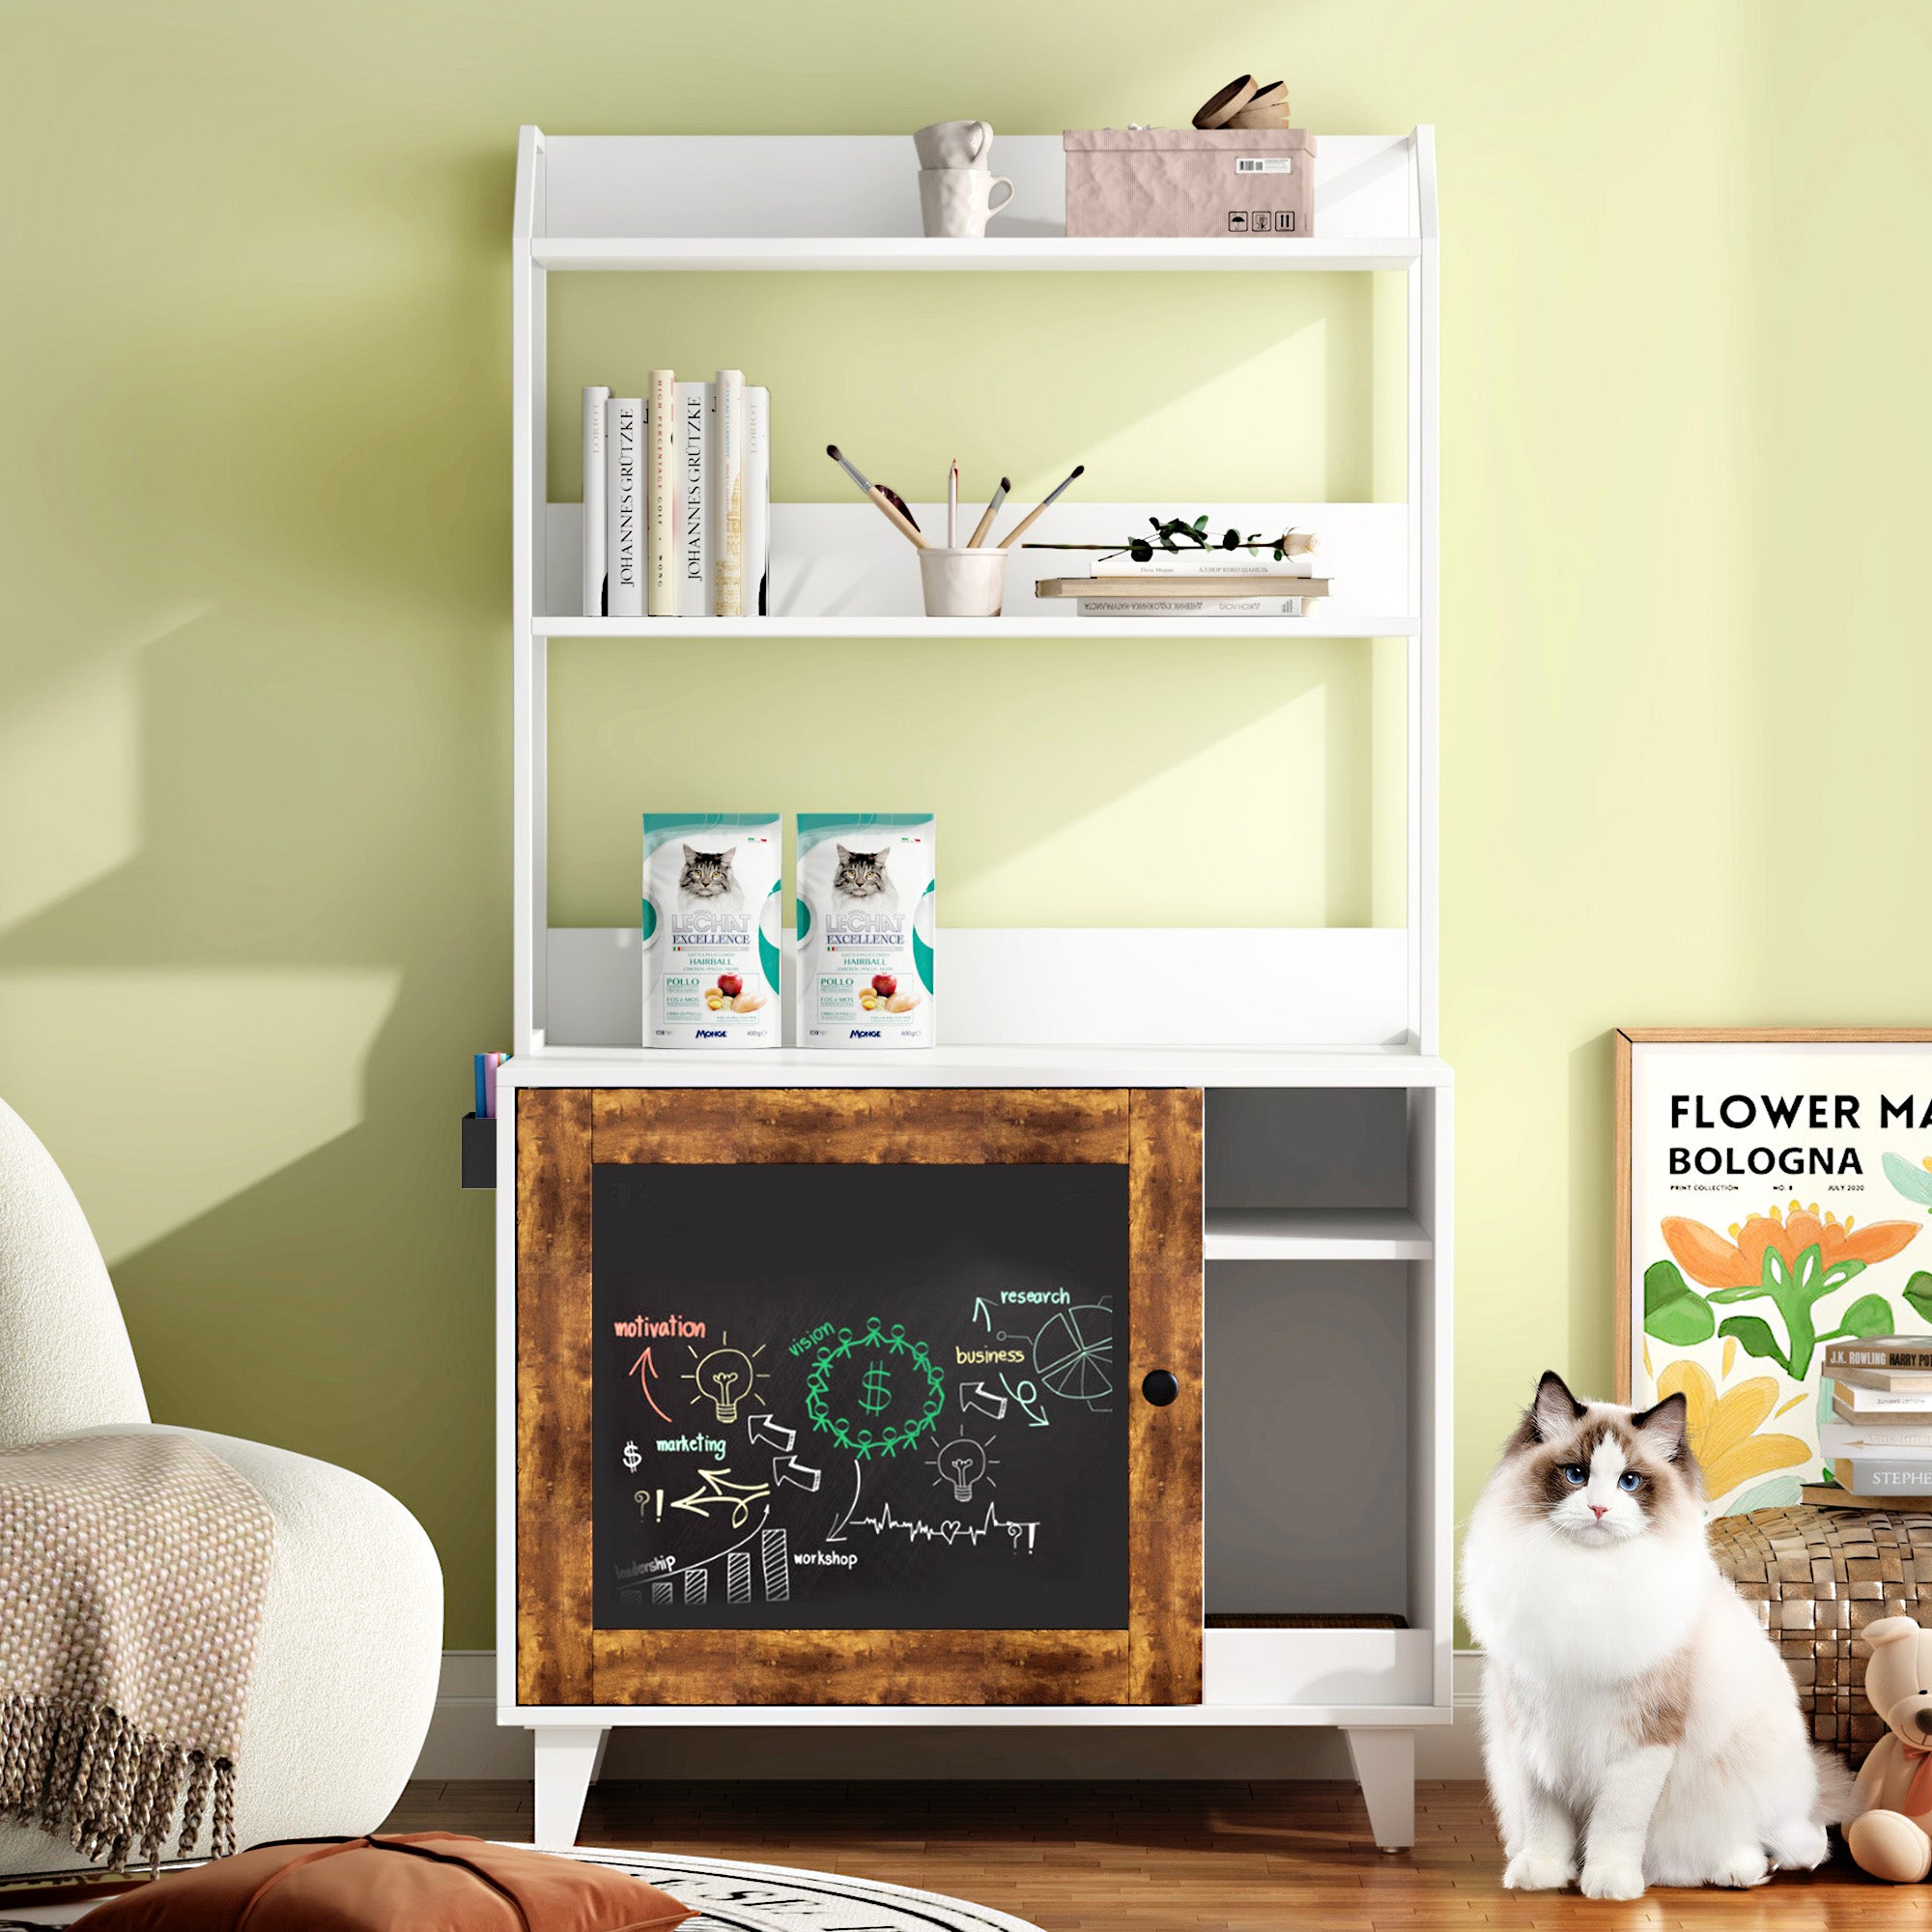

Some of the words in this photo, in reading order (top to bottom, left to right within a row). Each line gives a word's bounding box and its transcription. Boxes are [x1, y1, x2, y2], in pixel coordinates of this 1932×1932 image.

[618, 409, 634, 492] GRÜTZKE
[687, 396, 701, 483] GRÜTZKE
[620, 495, 636, 587] JOHANNES
[687, 486, 703, 582] JOHANNES
[673, 934, 751, 945] EXCELLENCE
[827, 934, 904, 945] EXCELLENCE
[696, 1030, 727, 1038] MONGE
[850, 1030, 881, 1038] MONGE
[1671, 1094, 1861, 1129] FLOWER
[1669, 1147, 1863, 1175] BOLOGNA
[1001, 1288, 1070, 1305] research
[613, 1316, 707, 1338] motivation
[788, 1320, 837, 1357] vision
[956, 1347, 1025, 1364] business
[1830, 1350, 1847, 1364] J.K.
[1849, 1351, 1887, 1366] ROWLING
[1889, 1353, 1917, 1367] HARRY
[622, 1440, 642, 1474] $
[656, 1435, 726, 1460] marketing
[794, 1550, 858, 1569] workshop
